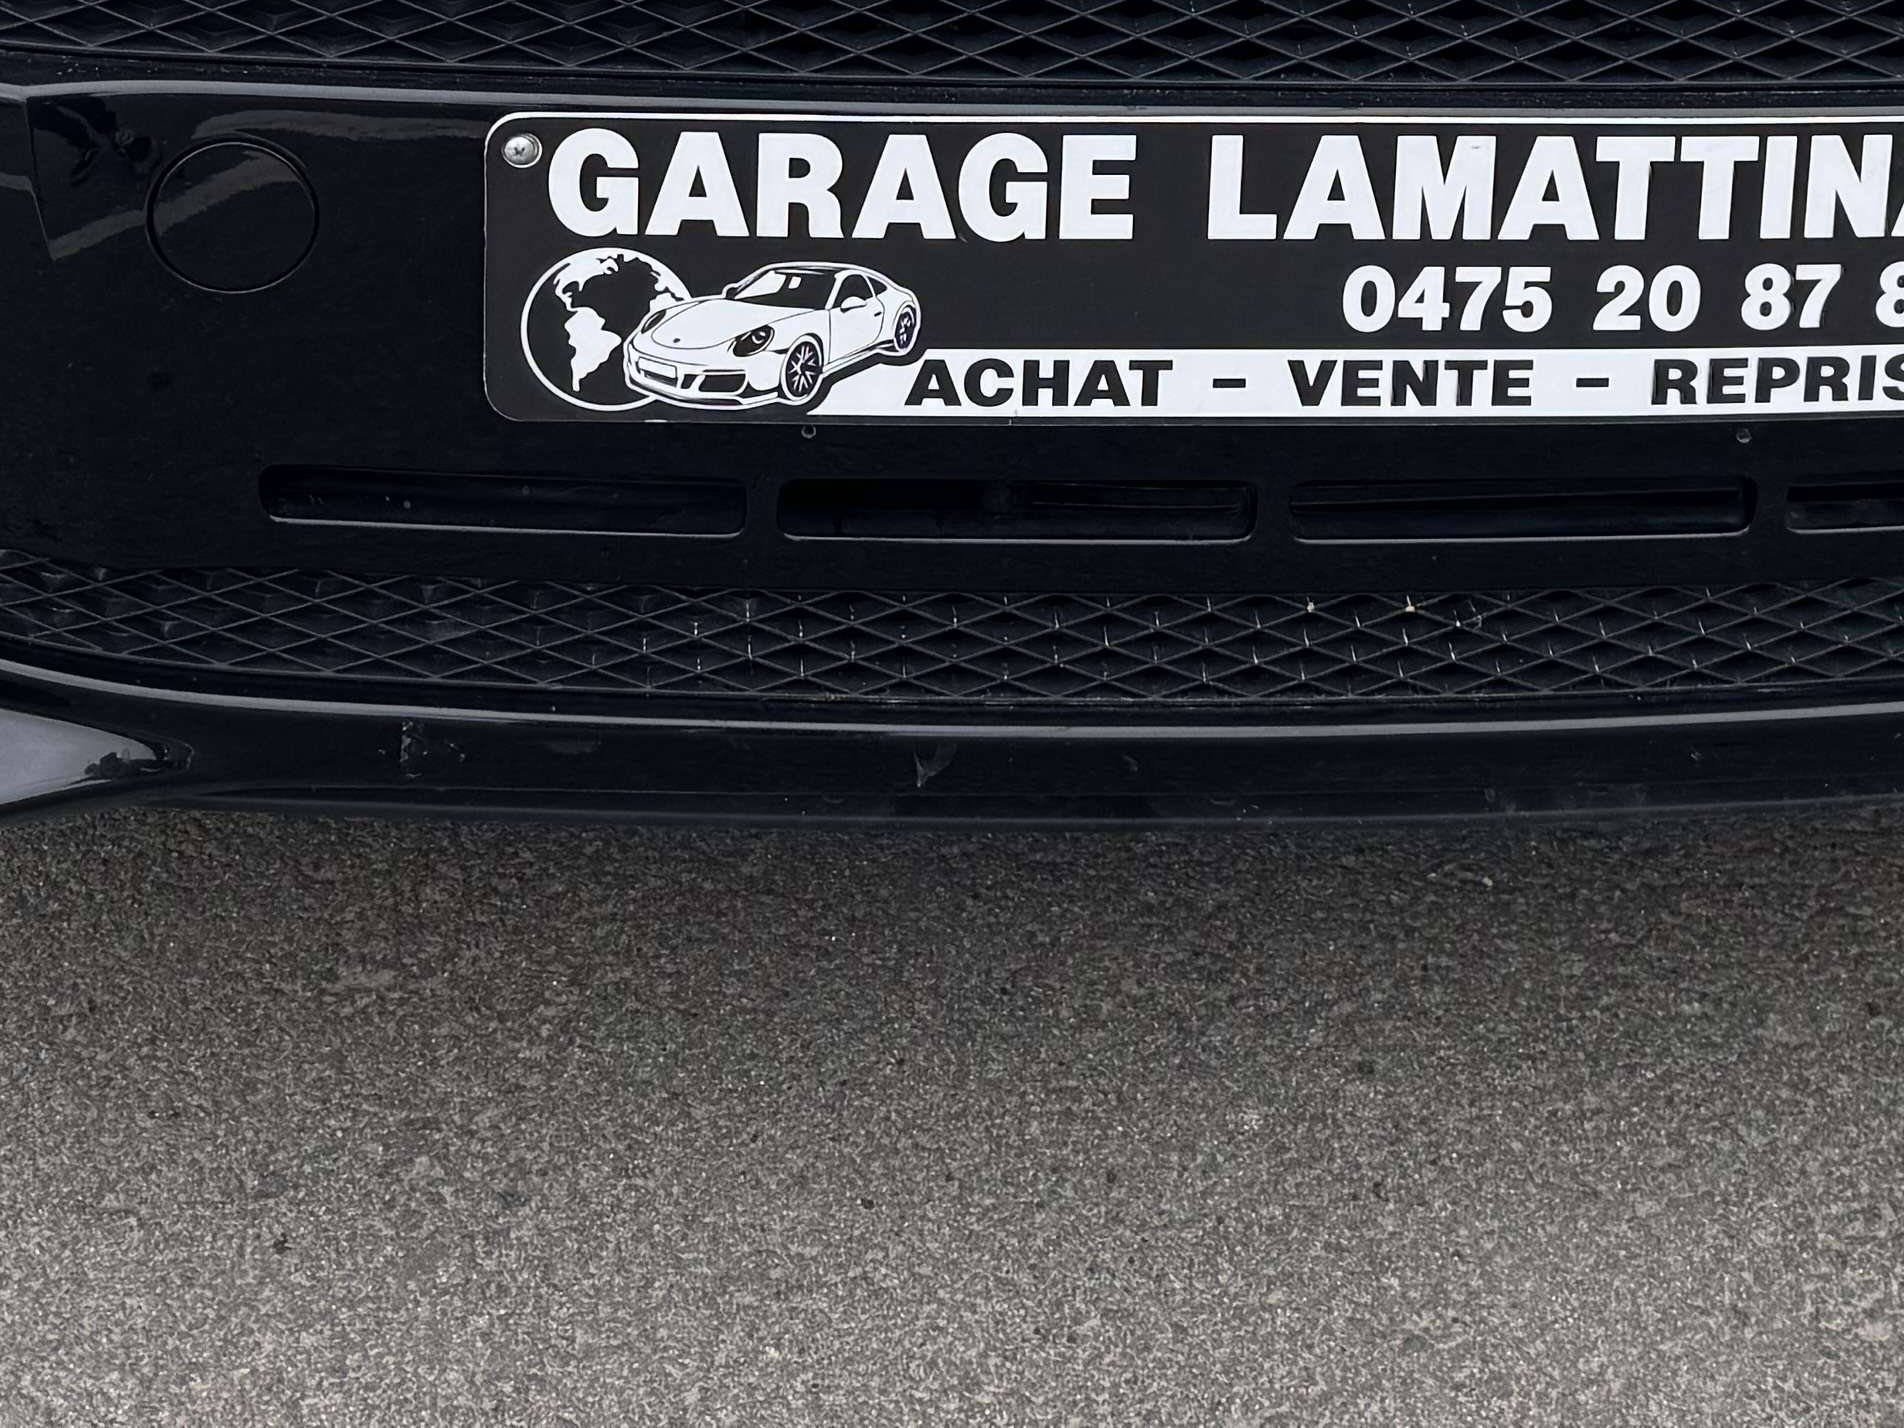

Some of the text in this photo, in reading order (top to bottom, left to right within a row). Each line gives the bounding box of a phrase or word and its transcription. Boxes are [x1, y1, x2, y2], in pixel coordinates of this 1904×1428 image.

[548, 128, 1137, 243] GARAGE
[1342, 264, 1552, 333] 0475
[1593, 264, 1700, 332] 20
[1741, 263, 1844, 331] 87
[903, 359, 1173, 408] ACHAT
[1288, 359, 1534, 408] VENTE
